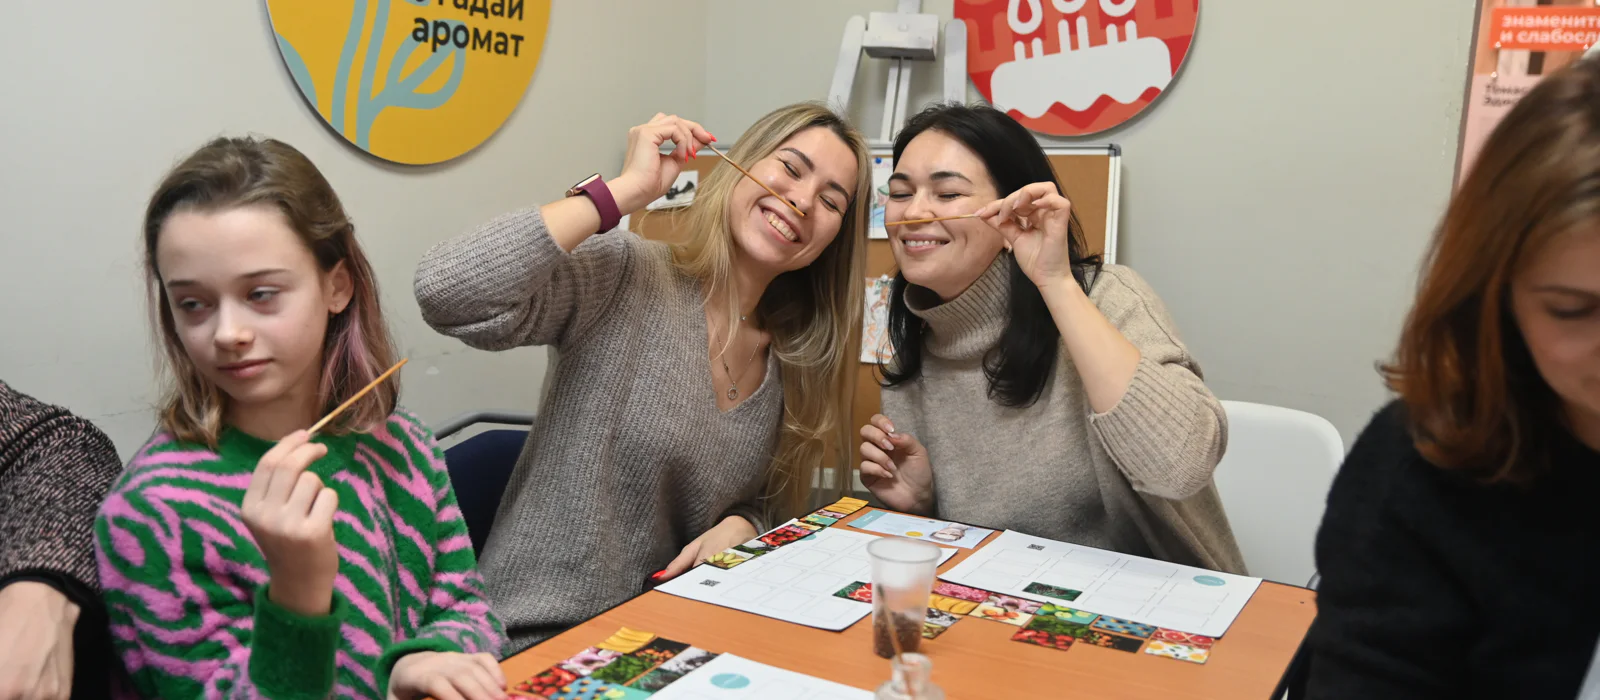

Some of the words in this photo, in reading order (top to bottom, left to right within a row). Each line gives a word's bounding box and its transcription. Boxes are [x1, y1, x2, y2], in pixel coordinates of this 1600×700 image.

[1501, 15, 1600, 28] знаменит
[412, 17, 524, 57] аромат
[1499, 30, 1514, 43] и
[1517, 28, 1600, 44] слабосл
